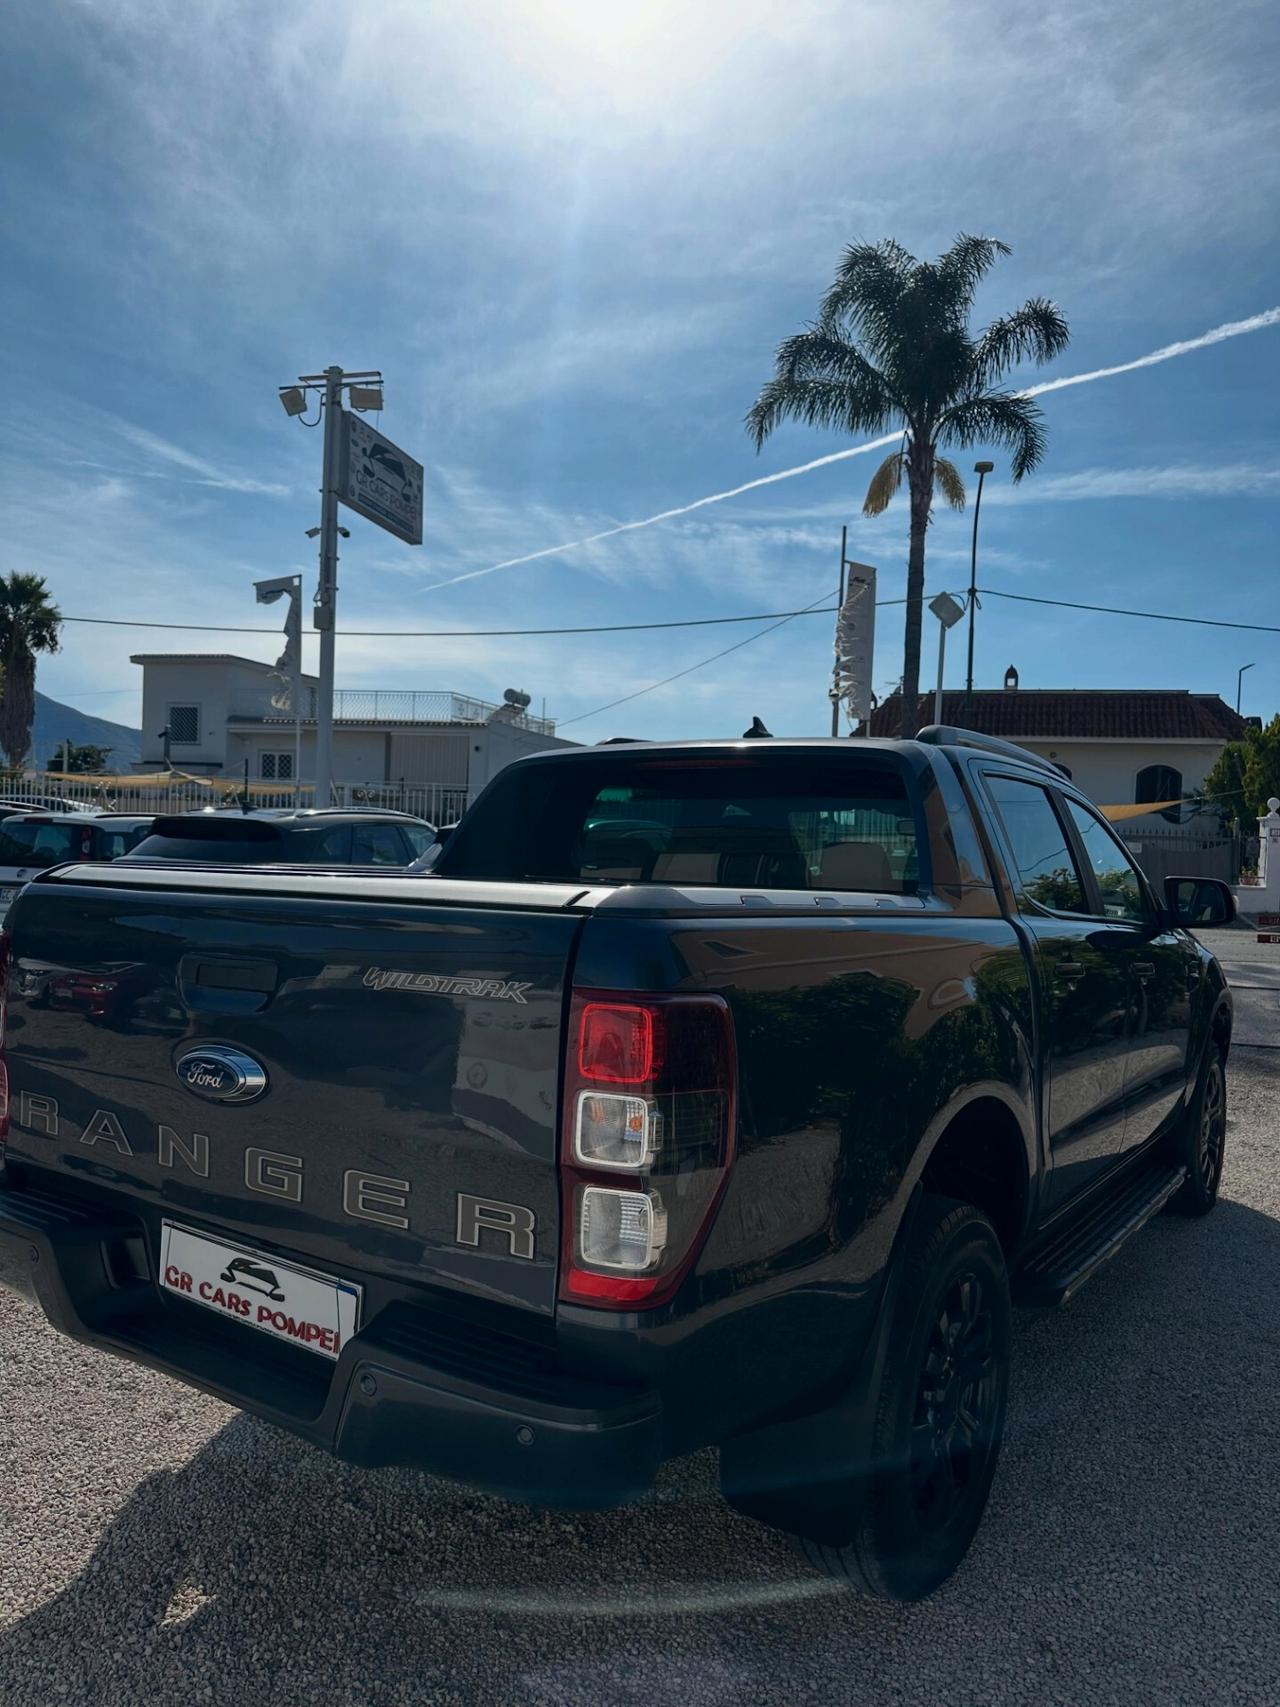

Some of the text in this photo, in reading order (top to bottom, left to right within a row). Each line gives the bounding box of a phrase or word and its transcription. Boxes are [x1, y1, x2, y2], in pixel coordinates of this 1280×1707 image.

[362, 967, 534, 1004] WILDTRAK
[187, 1062, 224, 1090] Ford
[20, 1090, 536, 1261] RANGER
[164, 1265, 193, 1293] GR
[199, 1281, 252, 1316] CARS
[256, 1305, 341, 1353] POMPEI
